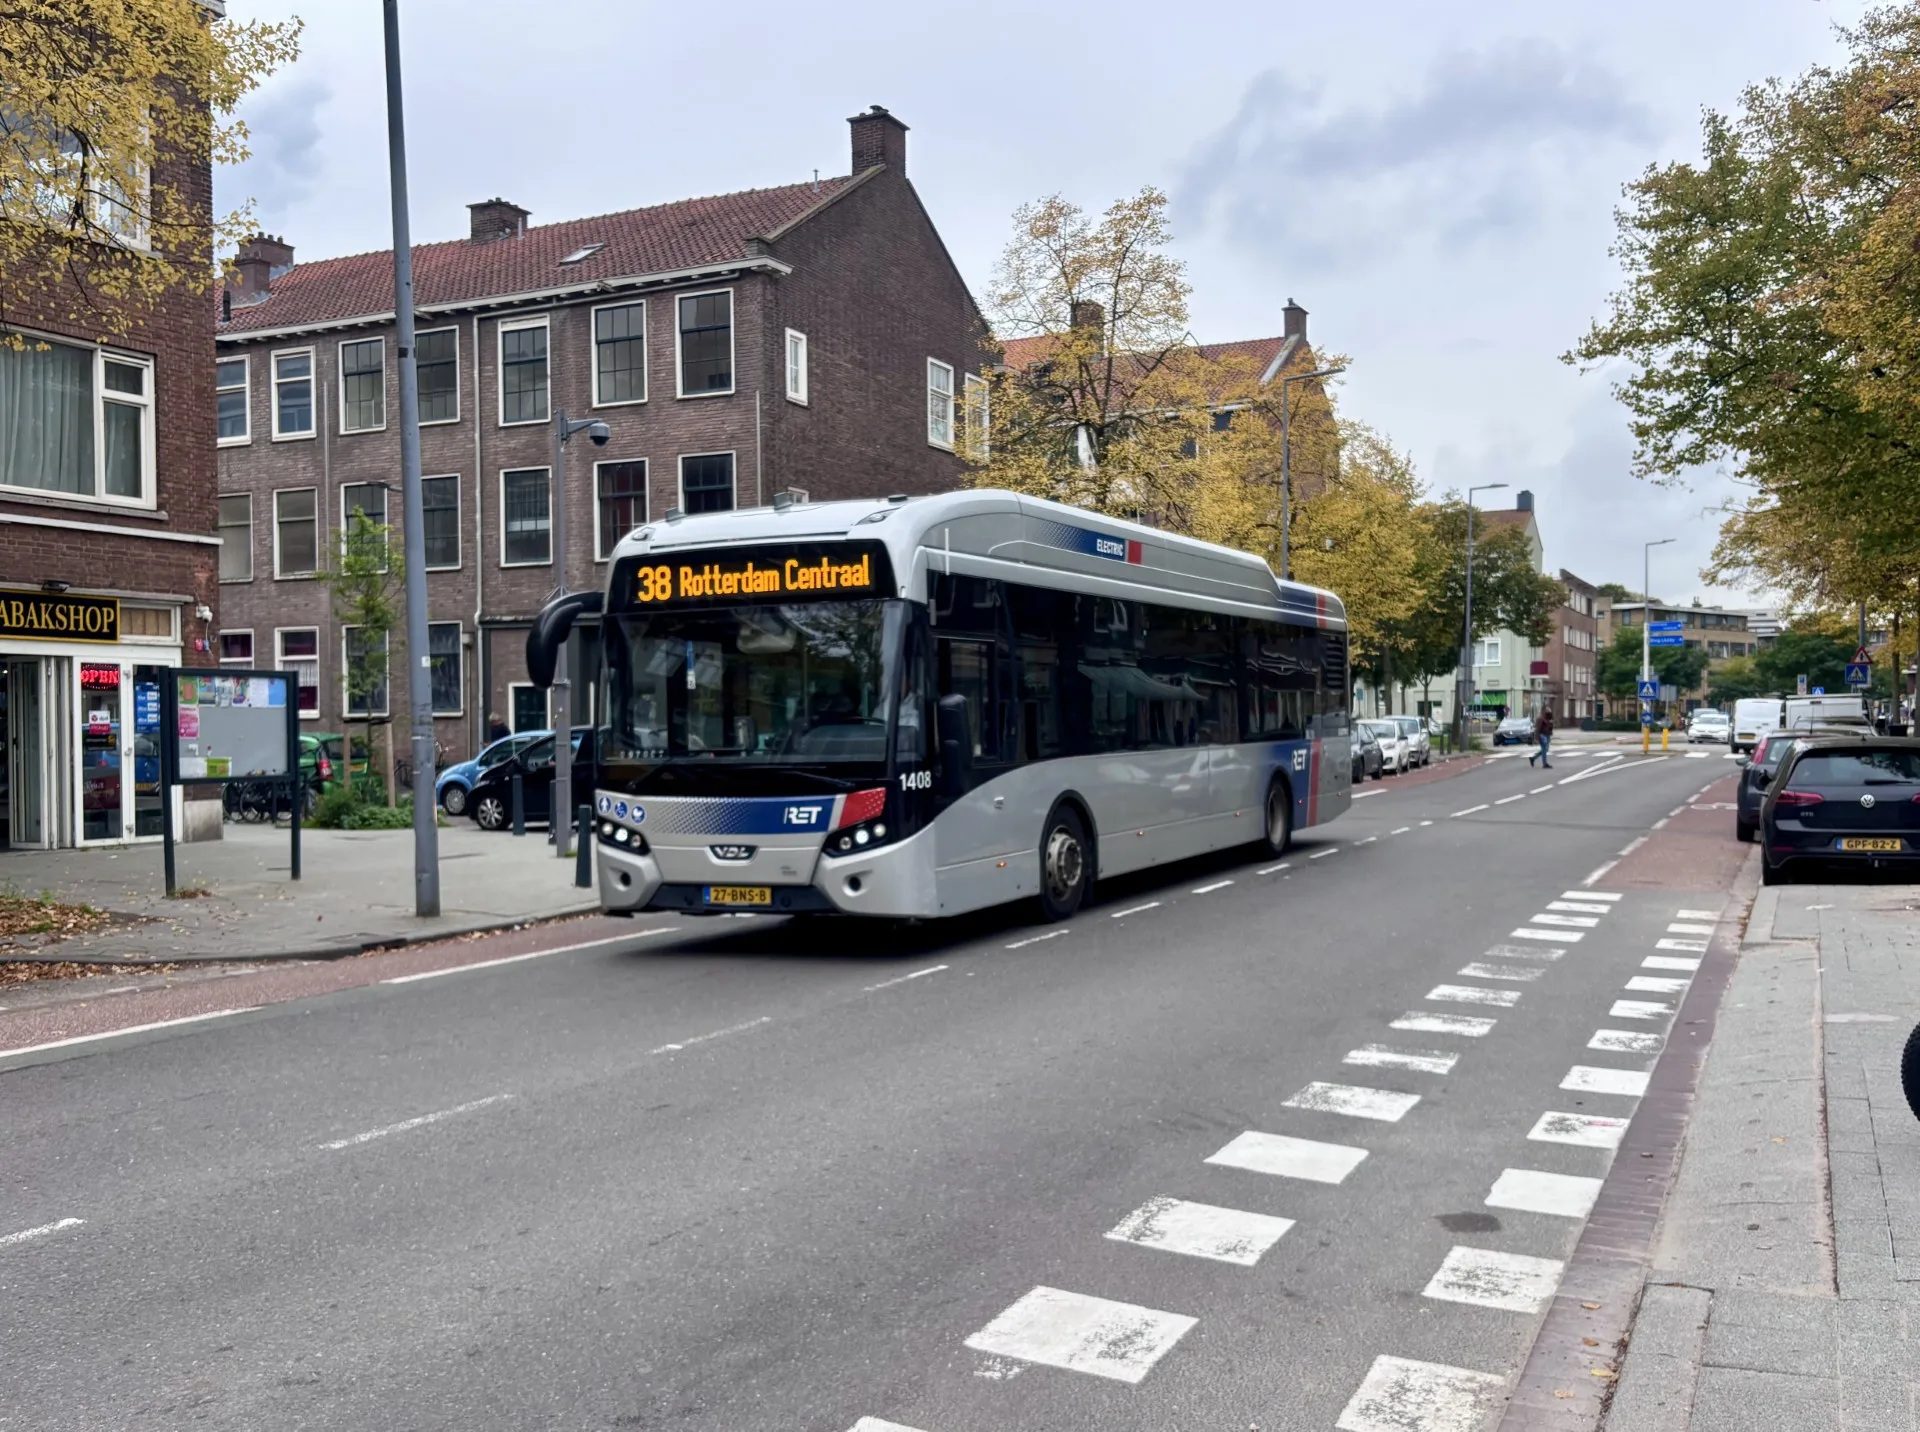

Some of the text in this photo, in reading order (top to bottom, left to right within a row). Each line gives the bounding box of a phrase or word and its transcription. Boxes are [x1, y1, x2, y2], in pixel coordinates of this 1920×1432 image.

[1096, 538, 1124, 557] ELECTRIC
[637, 554, 870, 602] 38 Rotterdam Centraal
[0, 600, 115, 633] ABAKSHOP
[80, 669, 119, 684] OPEN
[1292, 749, 1307, 771] RET
[899, 770, 932, 791] 1408
[783, 806, 823, 825] RET
[714, 846, 750, 858] VDL
[1846, 839, 1897, 849] GPF-82-Z
